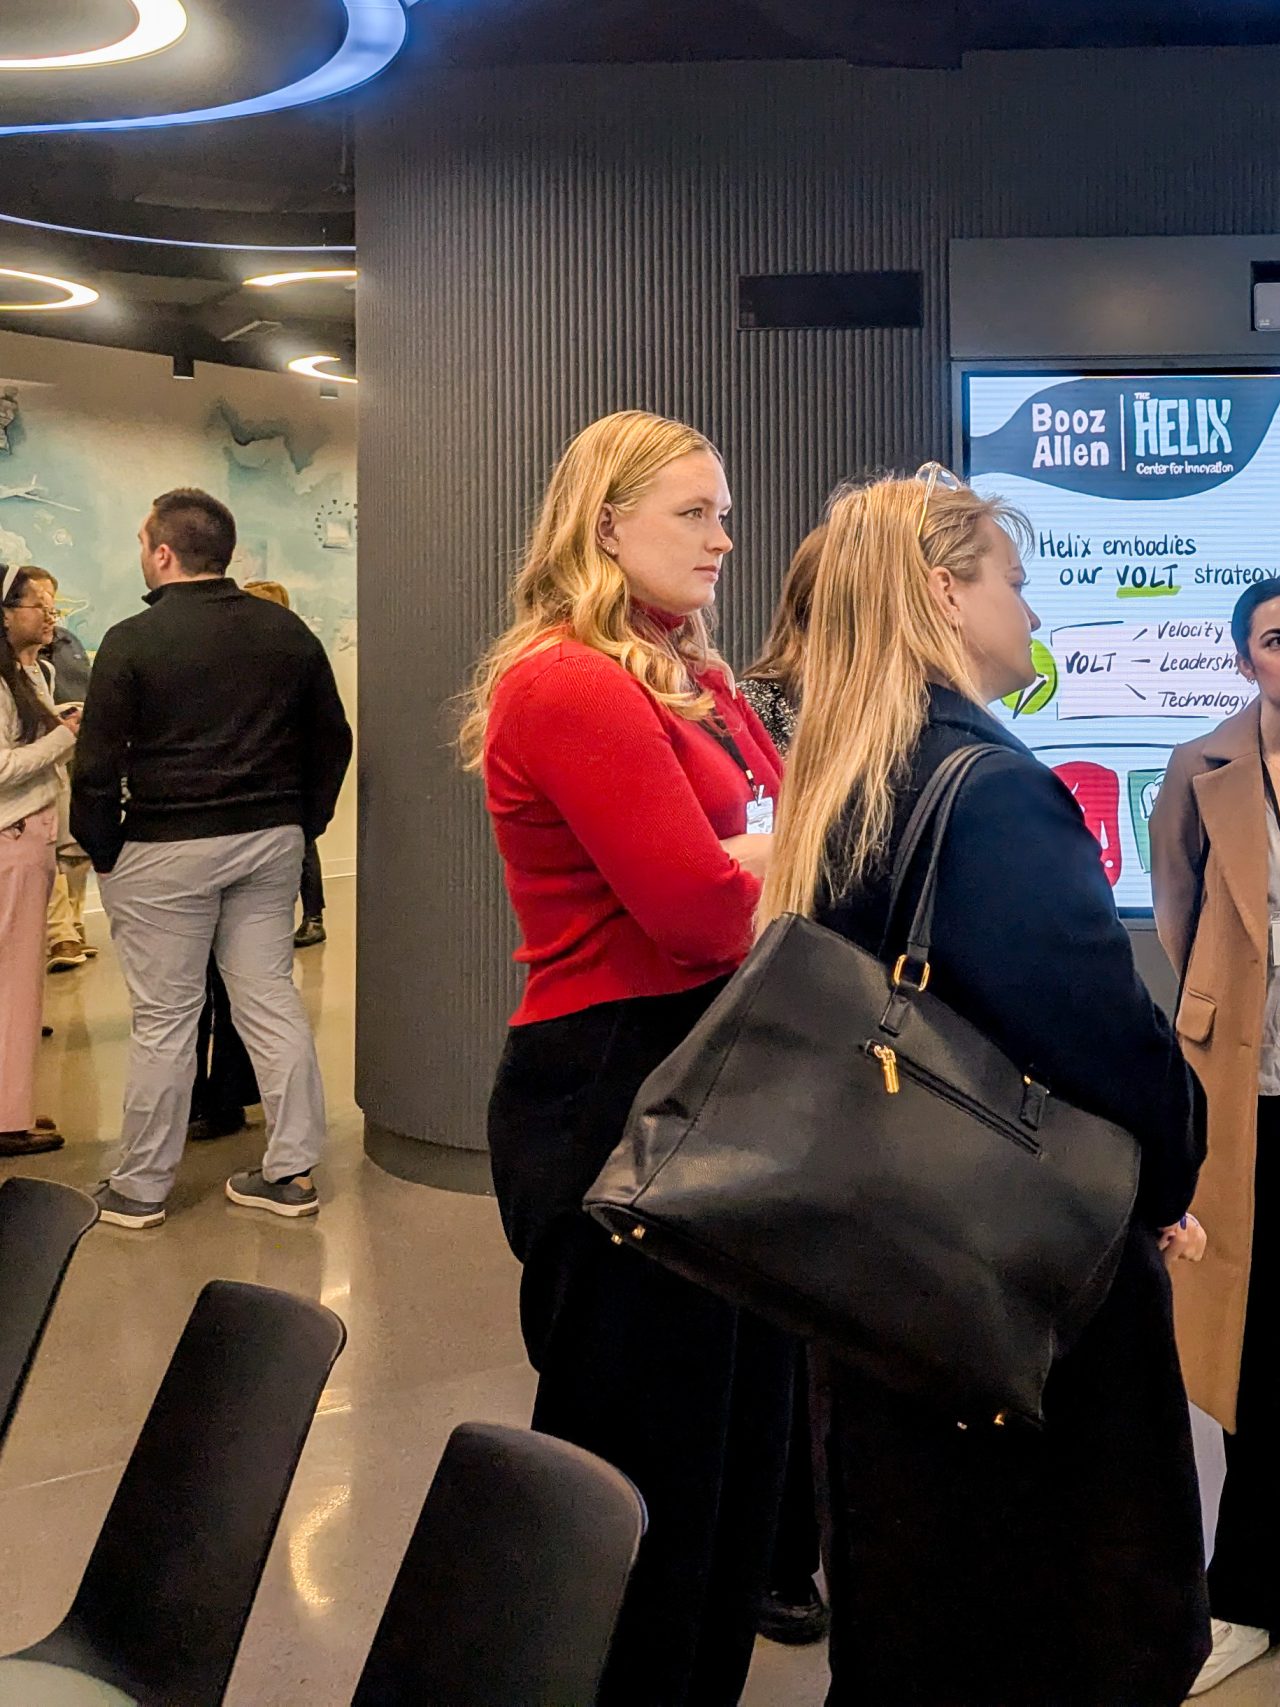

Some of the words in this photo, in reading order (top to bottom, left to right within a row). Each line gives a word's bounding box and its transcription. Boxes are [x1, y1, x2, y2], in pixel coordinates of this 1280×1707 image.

[1134, 392, 1151, 400] THE
[1032, 402, 1106, 434] Booz
[1133, 397, 1233, 457] HELIX
[1032, 434, 1110, 469] Allen
[1136, 462, 1168, 475] Center
[1169, 462, 1184, 475] for
[1184, 460, 1234, 474] Innovation
[1039, 529, 1092, 559] Helix
[1102, 534, 1197, 557] embodies
[1059, 566, 1103, 586] our
[1116, 563, 1179, 590] VOLT
[1157, 620, 1224, 645] Velocity
[1065, 650, 1117, 675] VOLT
[1157, 691, 1250, 715] Technology
